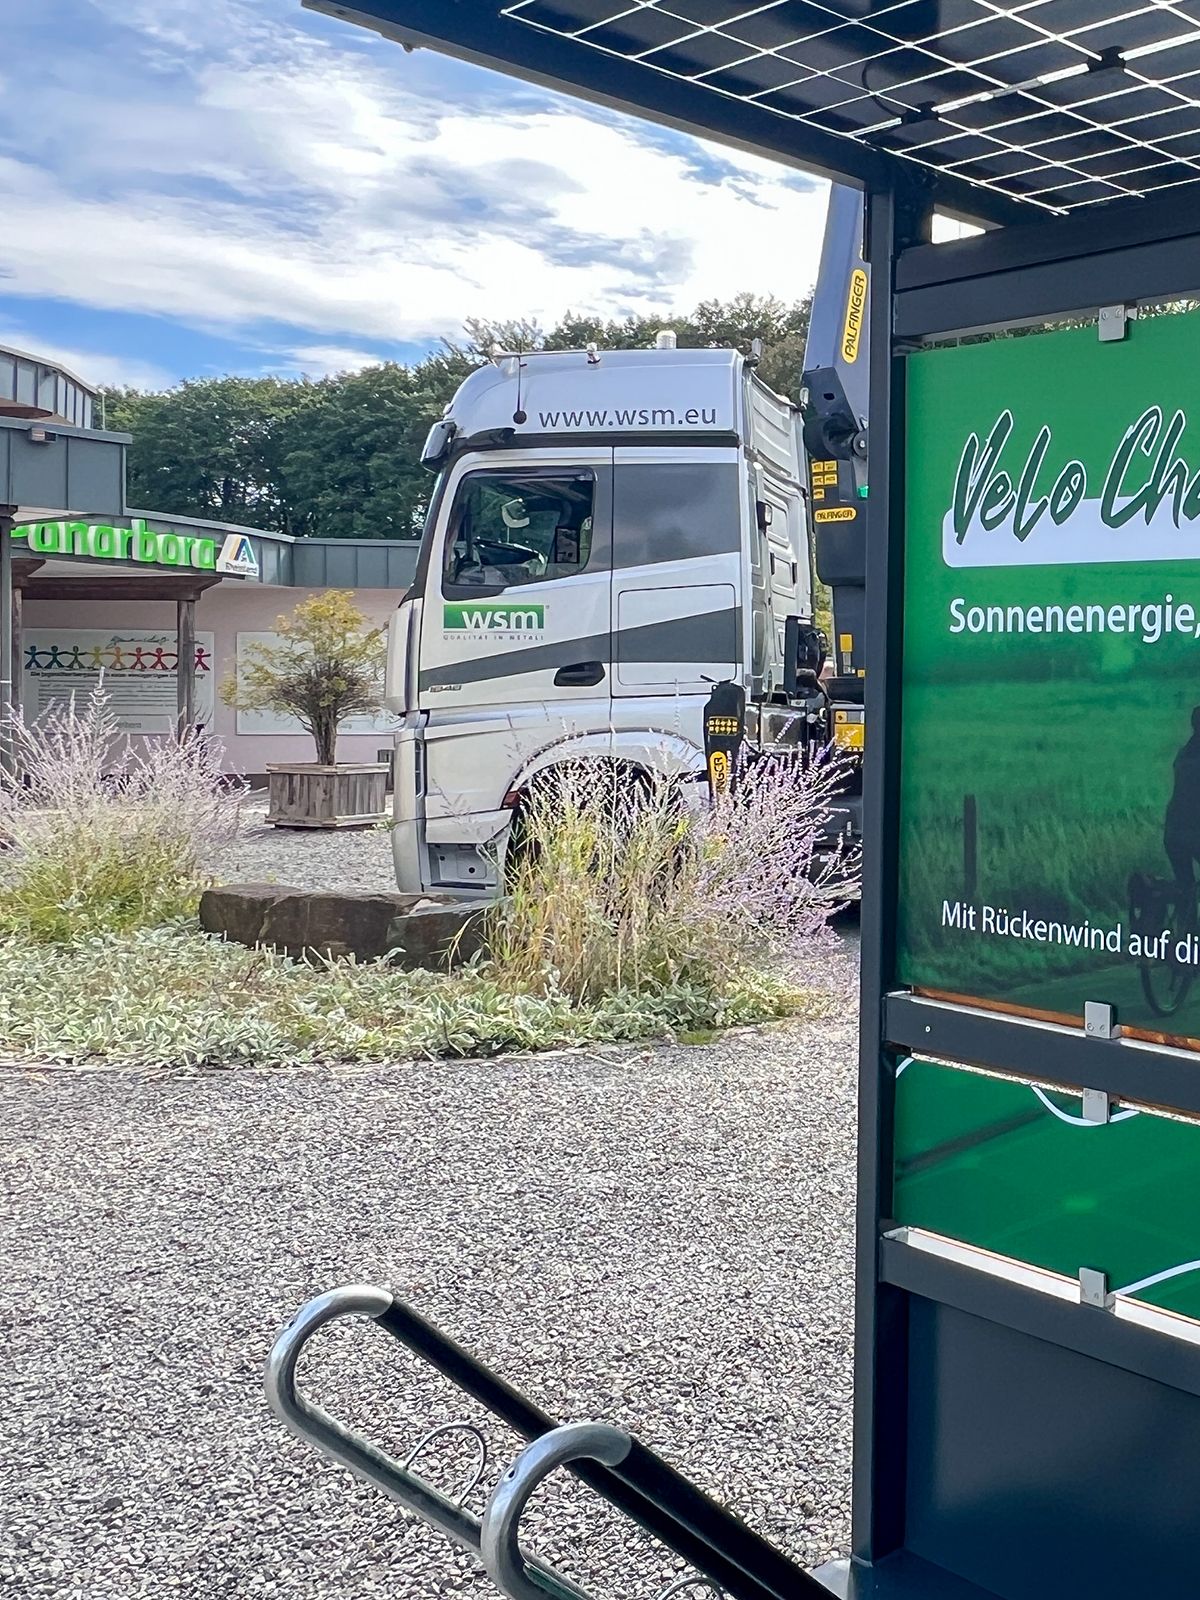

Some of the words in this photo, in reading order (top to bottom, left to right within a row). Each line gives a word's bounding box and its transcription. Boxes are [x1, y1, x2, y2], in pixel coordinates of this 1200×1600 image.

[844, 275, 865, 358] PALFINGER
[538, 407, 717, 428] www.wsm.eu
[461, 610, 539, 630] wsm
[940, 899, 977, 933] Mit
[981, 903, 1122, 954] Rückenwind
[1127, 930, 1170, 961] auf
